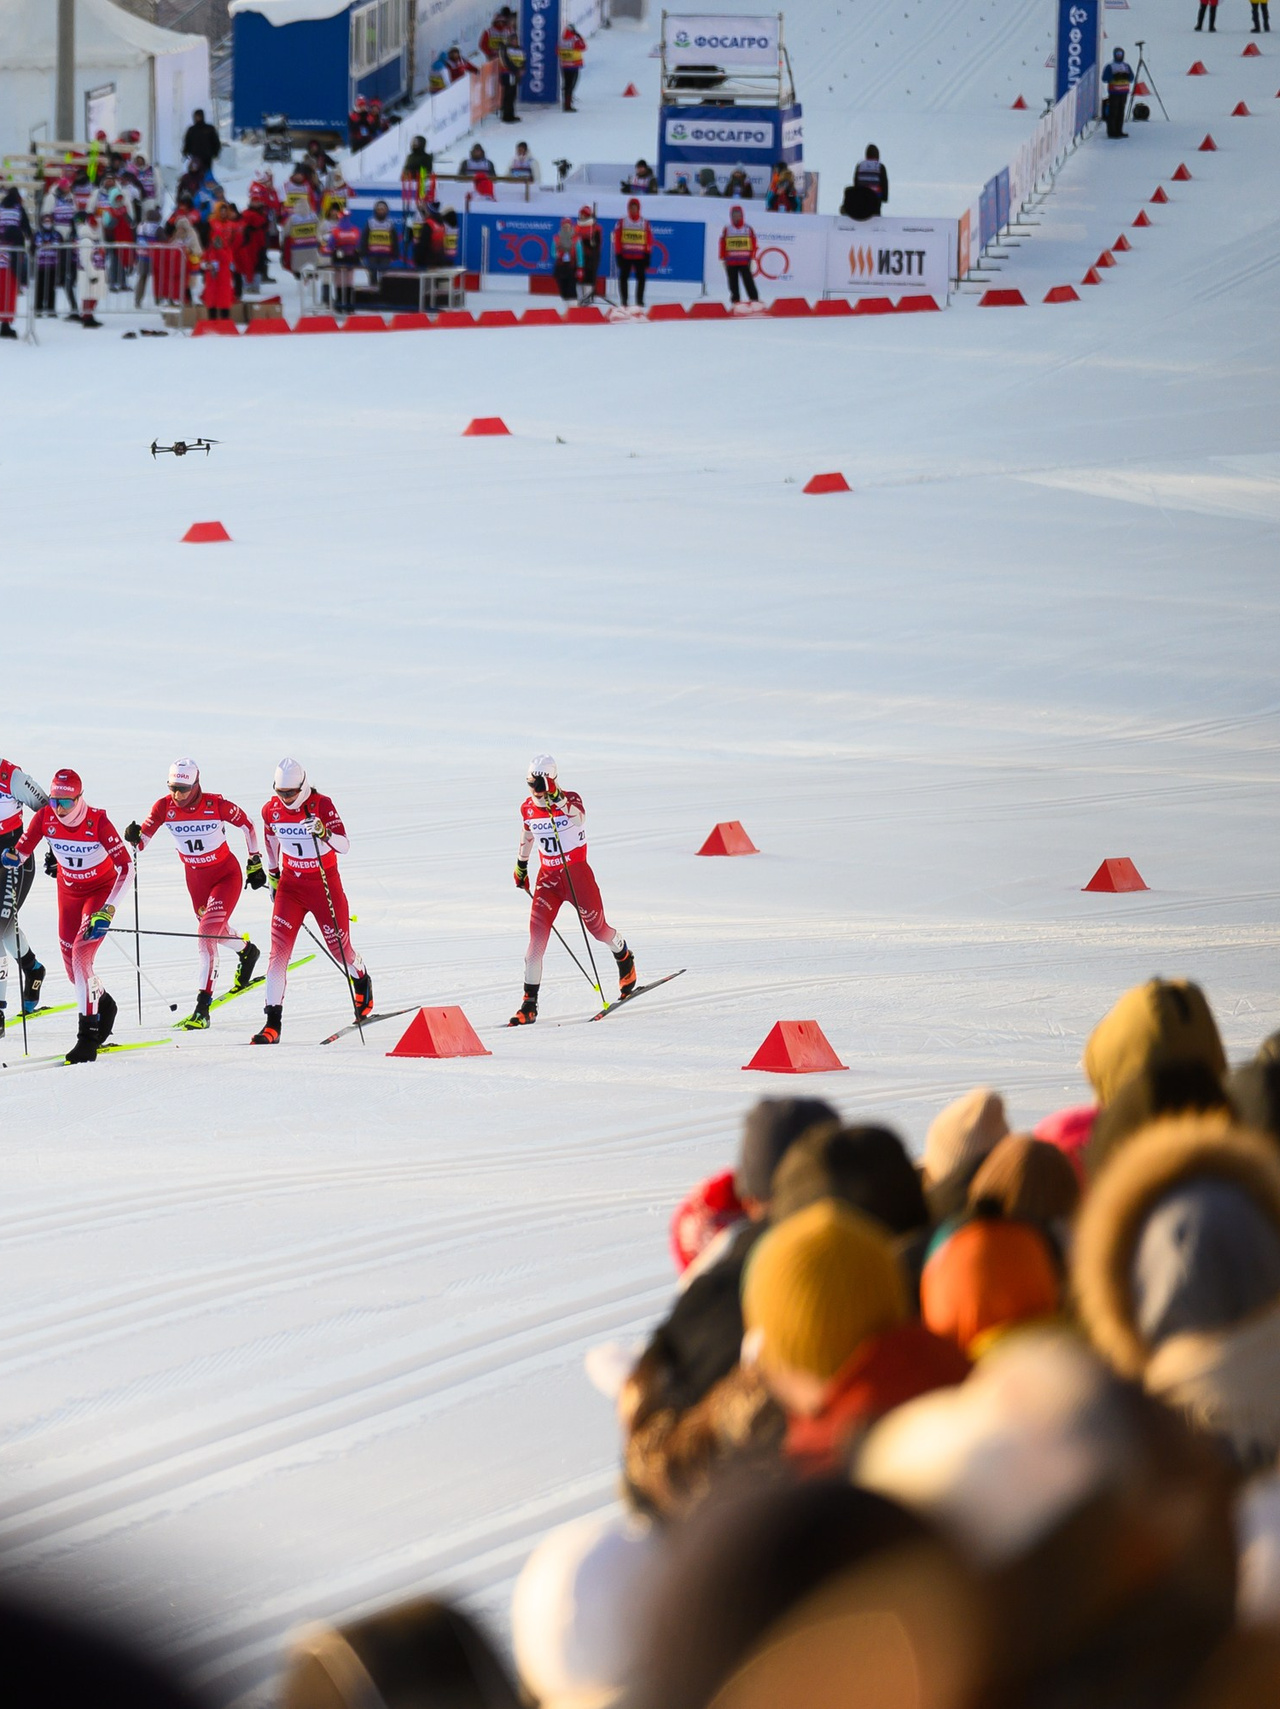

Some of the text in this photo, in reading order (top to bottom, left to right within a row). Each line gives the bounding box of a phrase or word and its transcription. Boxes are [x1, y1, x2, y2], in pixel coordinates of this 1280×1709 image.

[694, 36, 769, 49] ФОСАГРО
[691, 129, 766, 143] ФОСАГРО
[878, 249, 926, 276] ИЗТТ
[175, 822, 218, 833] ФОСАГРО
[279, 827, 312, 835] ФОСАГ
[532, 819, 569, 830] ФОСАРО
[54, 843, 100, 853] ФОСАГРО
[184, 839, 205, 853] 14
[292, 843, 303, 856] 7
[540, 836, 558, 853] 27
[183, 854, 218, 864] ИЖЕВСК
[61, 866, 98, 880] ИЖЕВСК
